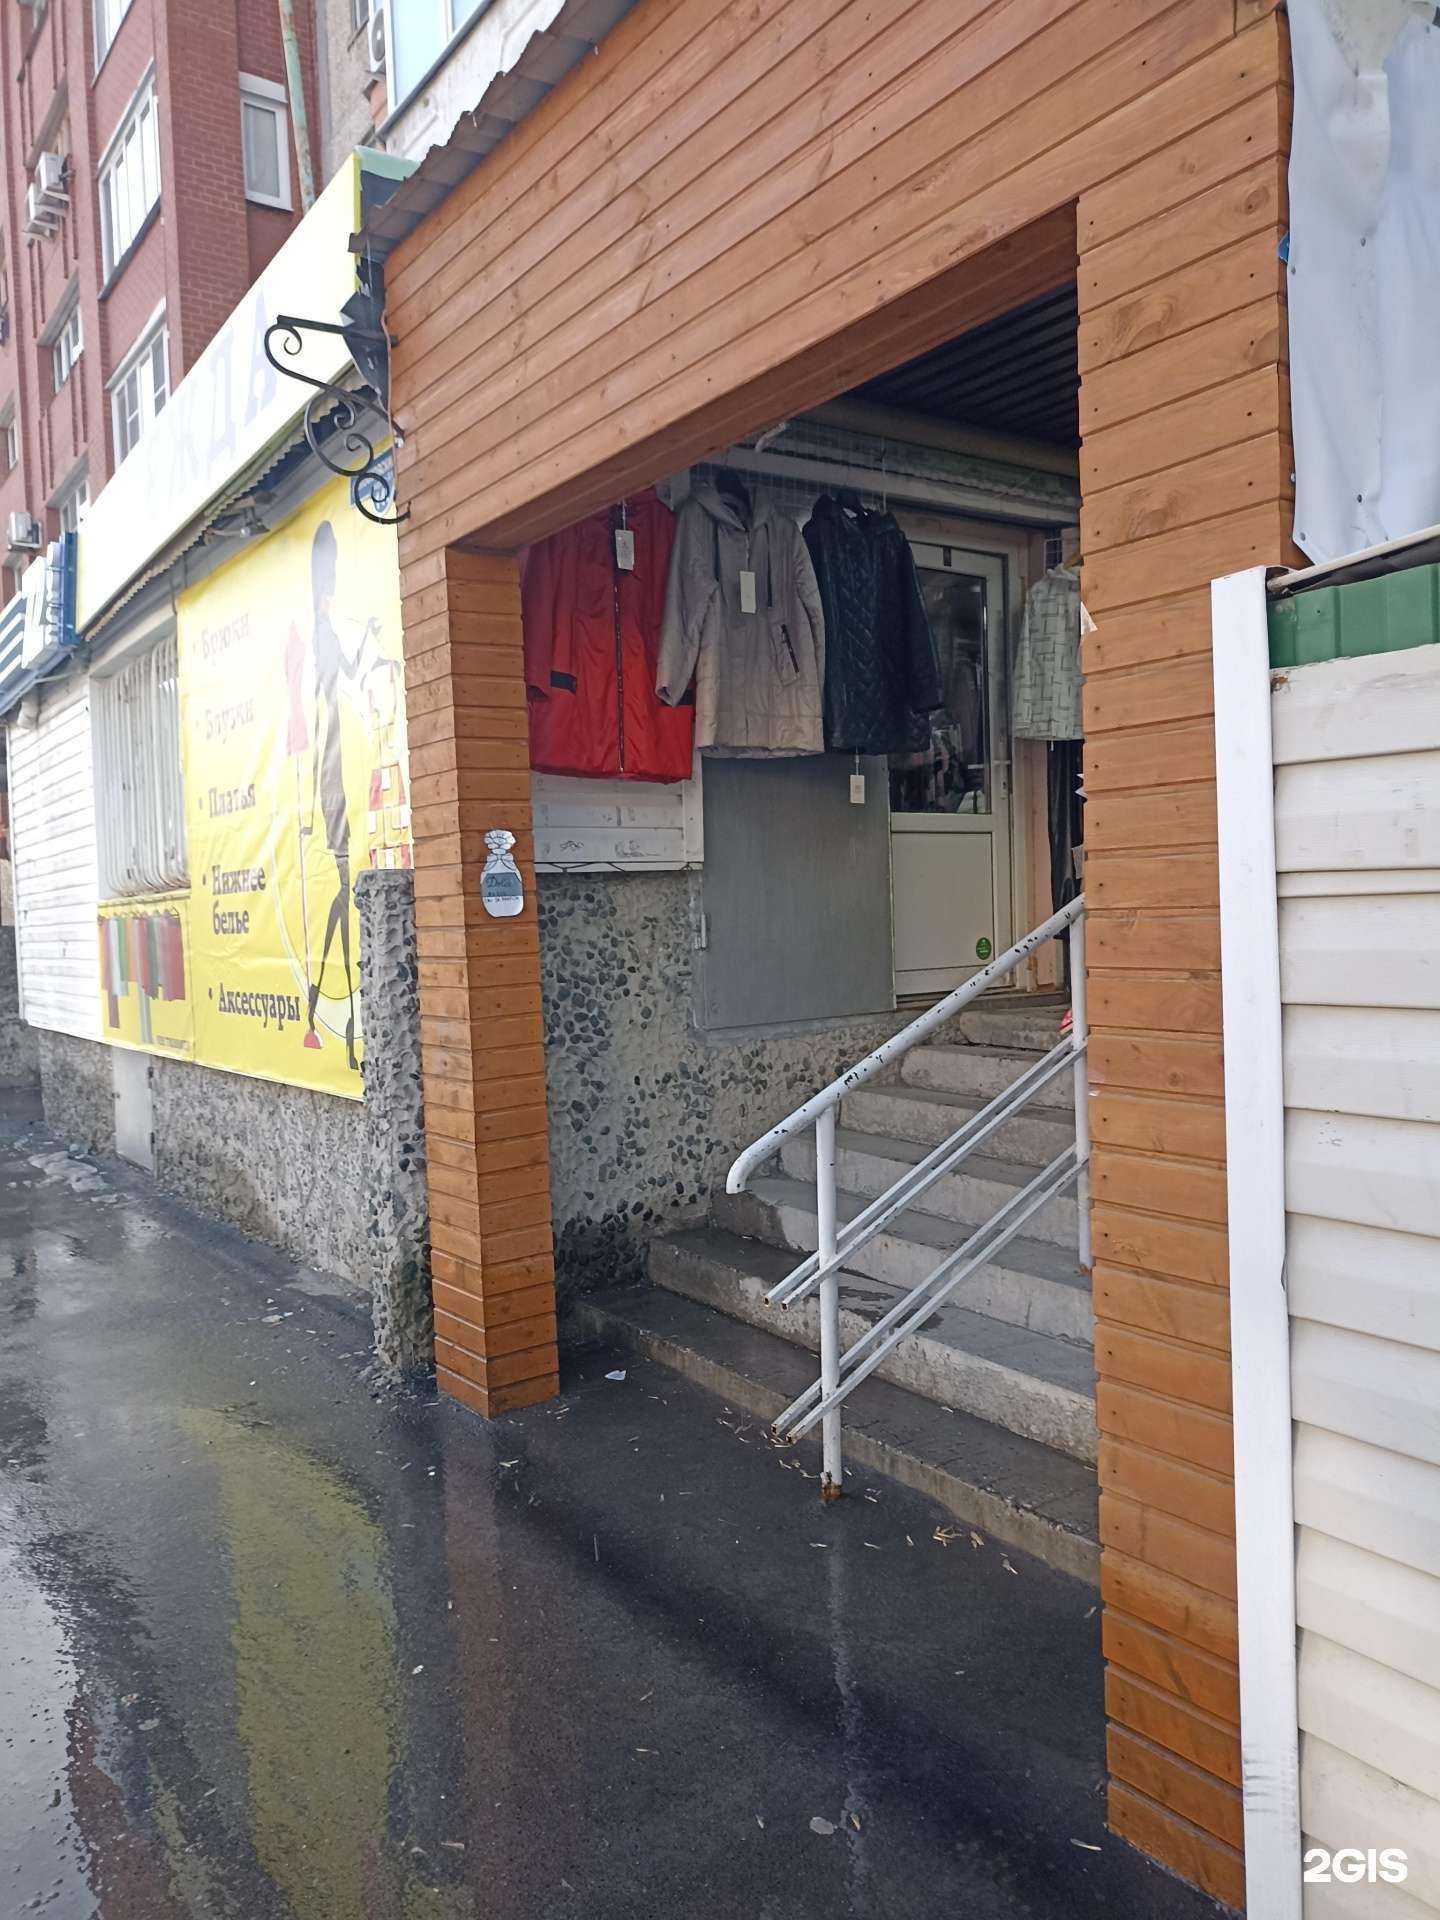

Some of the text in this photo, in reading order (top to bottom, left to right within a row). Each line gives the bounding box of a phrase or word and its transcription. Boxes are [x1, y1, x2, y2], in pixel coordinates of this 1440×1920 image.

[201, 613, 249, 664] Брюки
[205, 698, 254, 744] Блузки
[208, 783, 256, 818] Платья
[212, 864, 265, 896] Нижнее
[213, 901, 249, 935] белье
[218, 982, 300, 1030] Аксессуары
